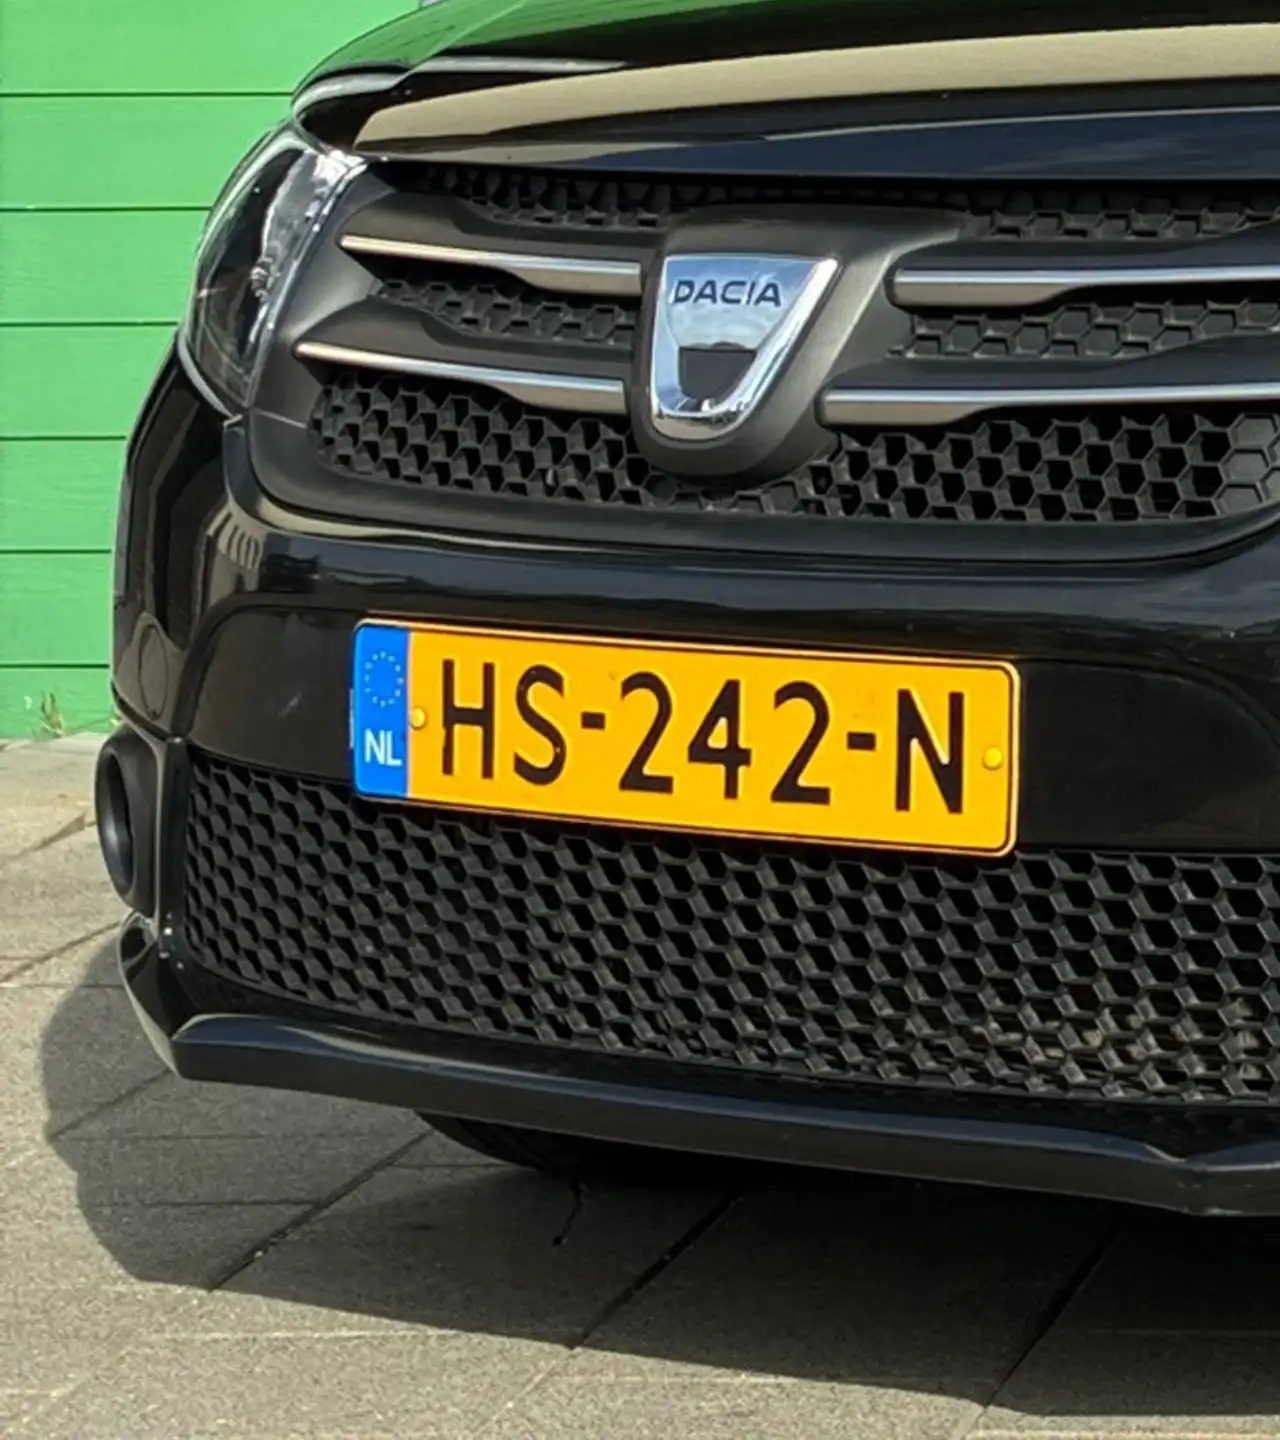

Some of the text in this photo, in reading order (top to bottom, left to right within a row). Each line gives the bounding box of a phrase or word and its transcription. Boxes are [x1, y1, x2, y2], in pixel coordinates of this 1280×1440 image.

[671, 279, 783, 308] DACIA
[363, 728, 402, 768] NL
[441, 658, 965, 815] HS-242-N
